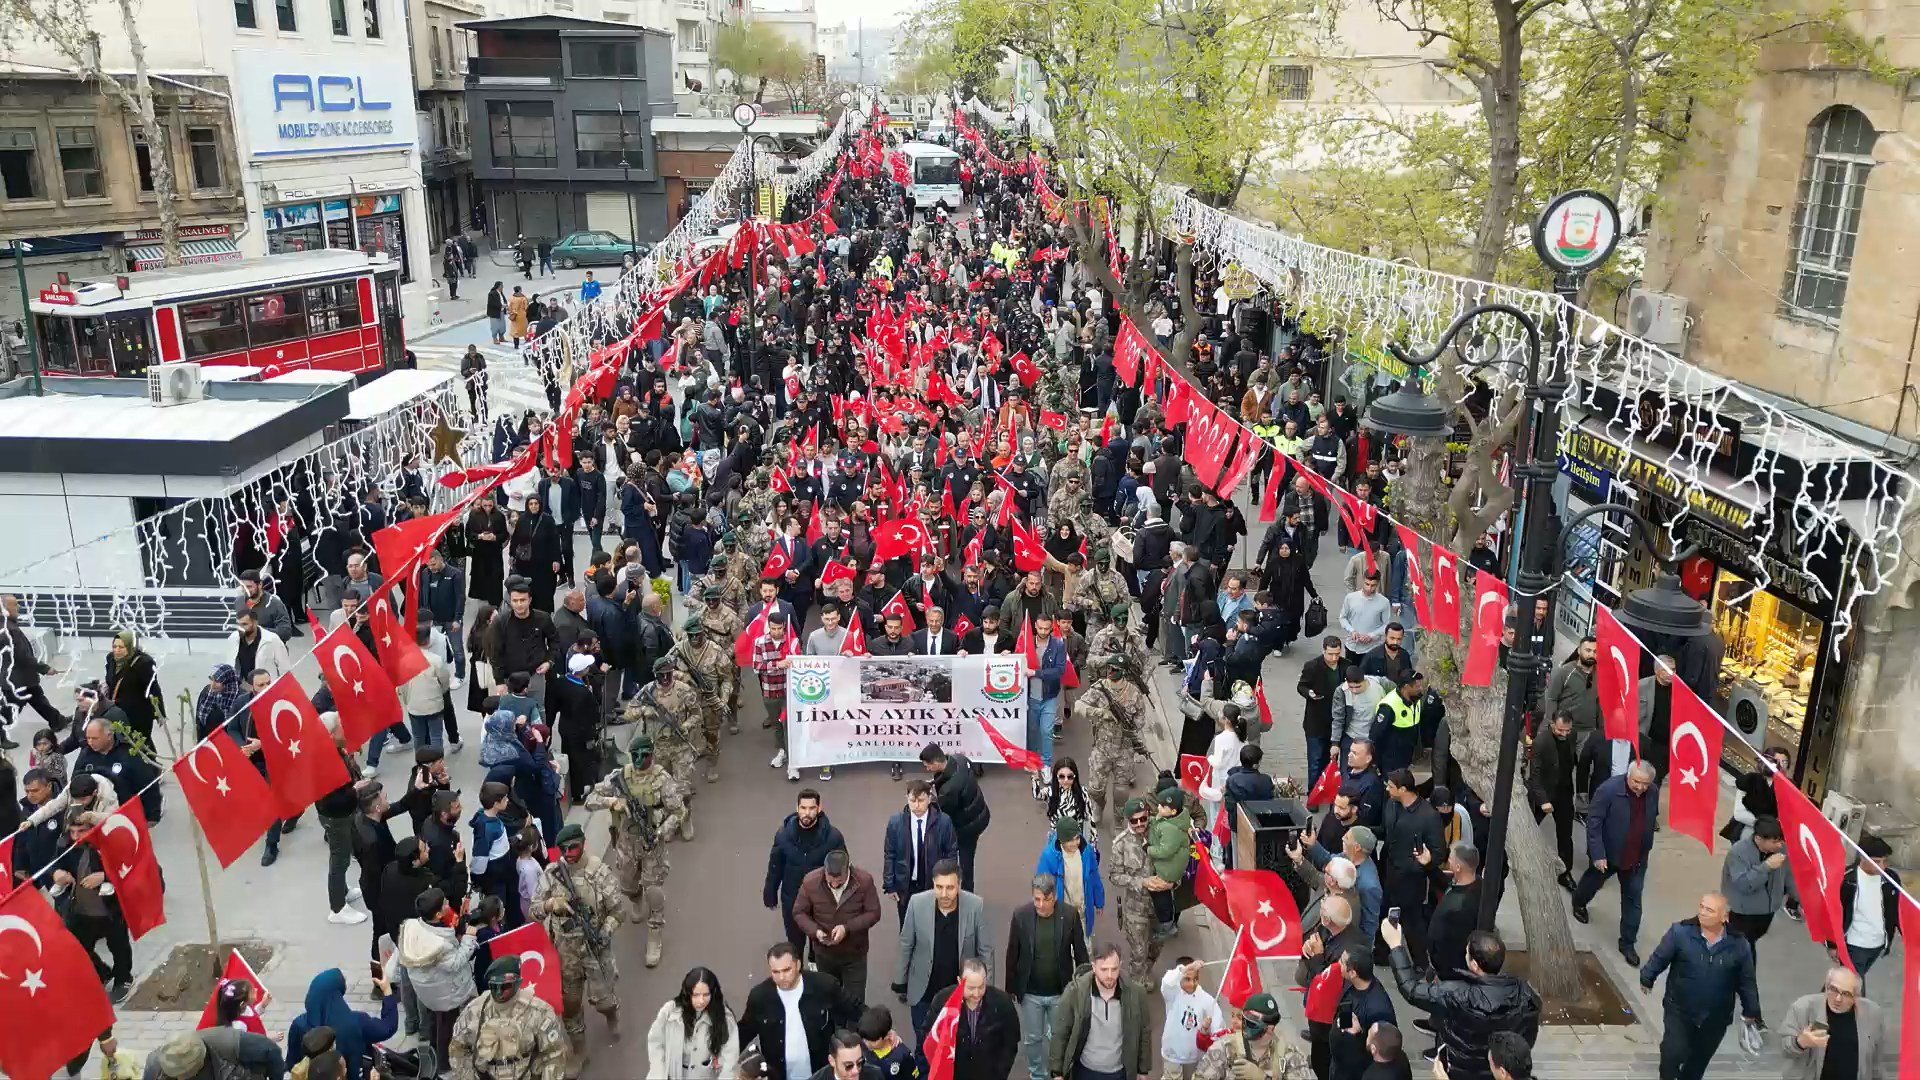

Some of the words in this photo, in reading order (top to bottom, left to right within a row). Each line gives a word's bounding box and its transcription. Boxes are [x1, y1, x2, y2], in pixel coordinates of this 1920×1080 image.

[273, 74, 392, 112] ACL
[1570, 460, 1601, 488] iletişim
[796, 707, 871, 722] LİMAN
[880, 708, 935, 720] AYIK
[855, 721, 962, 736] DERNEĞİ
